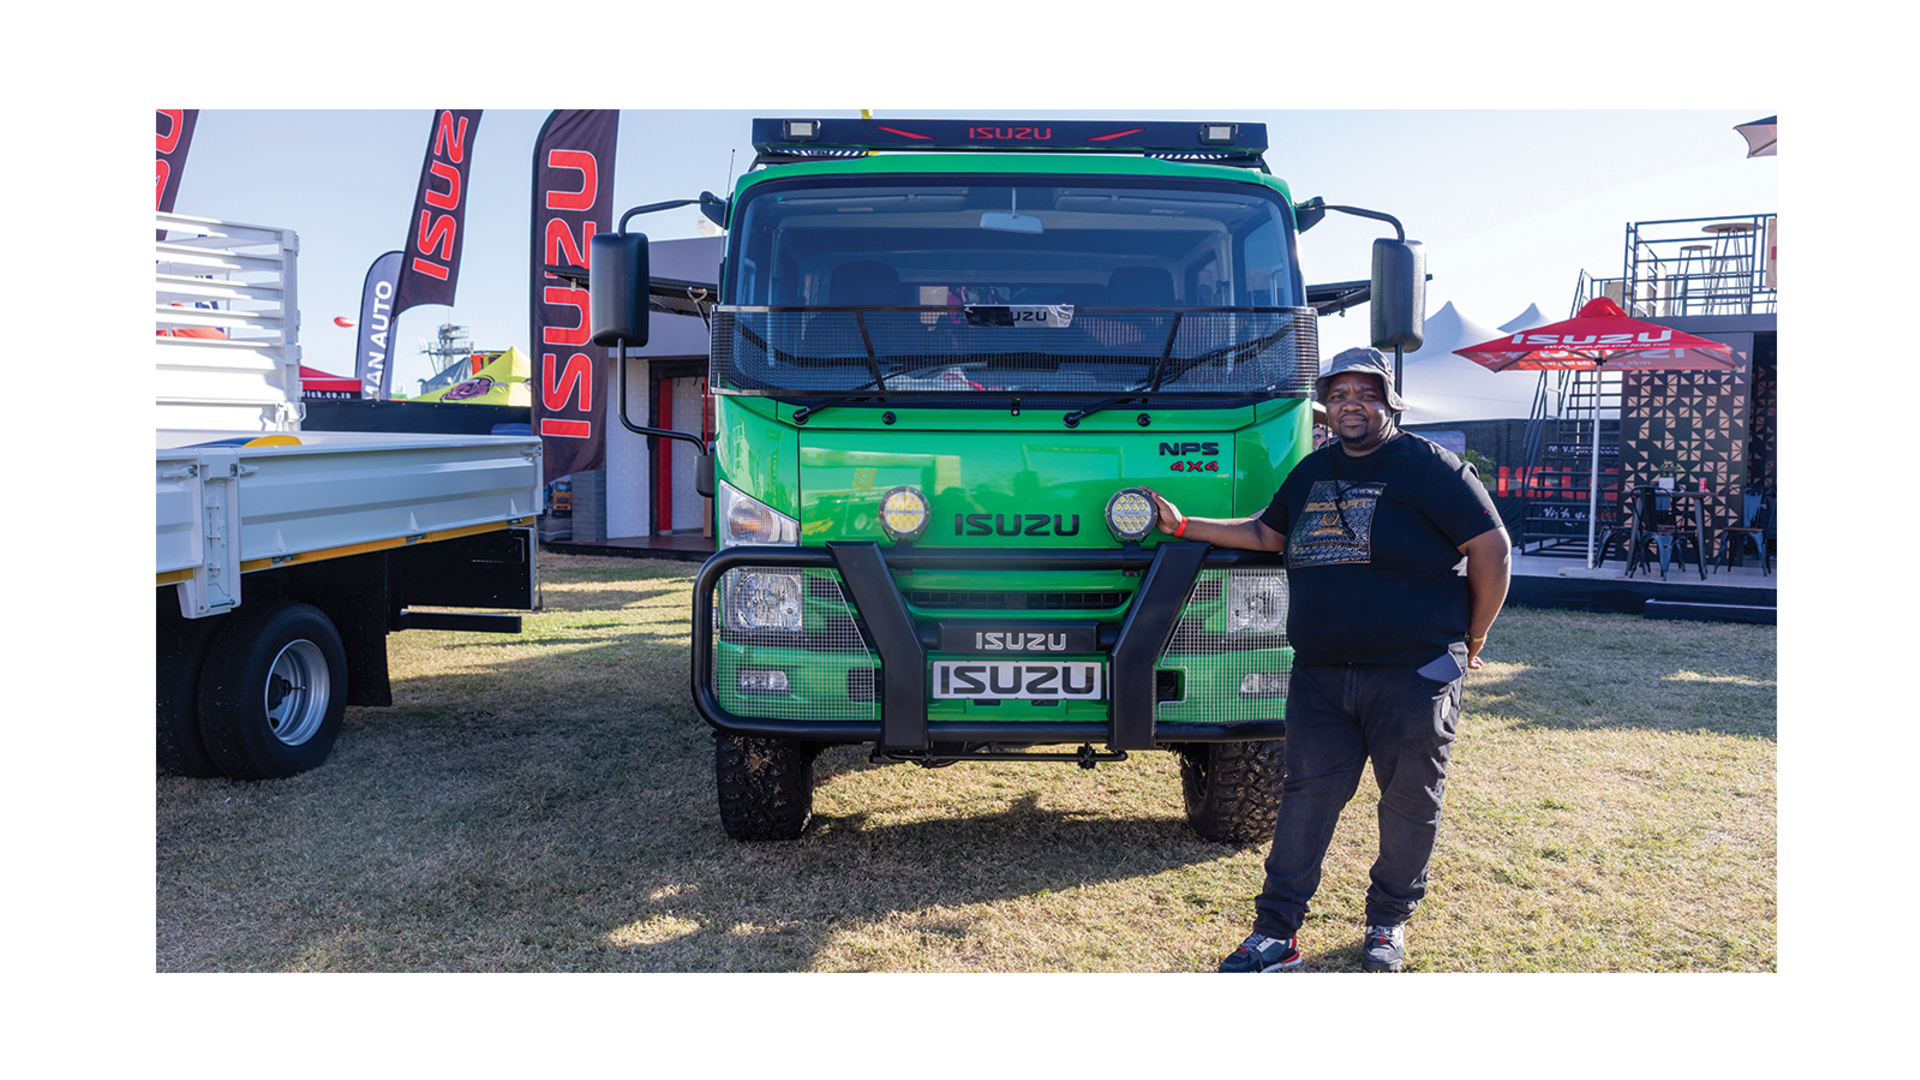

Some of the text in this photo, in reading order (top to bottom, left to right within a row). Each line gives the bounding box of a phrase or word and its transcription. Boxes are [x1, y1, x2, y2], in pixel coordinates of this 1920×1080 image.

[969, 126, 1051, 140] ISUZU
[541, 149, 598, 438] ISUZU
[370, 280, 393, 349] AUTO
[1511, 330, 1673, 345] ISUZU
[1159, 442, 1219, 456] NPS
[954, 513, 1080, 537] ISUZU
[976, 632, 1067, 651] ISUZU
[940, 666, 1095, 695] ISUZU
